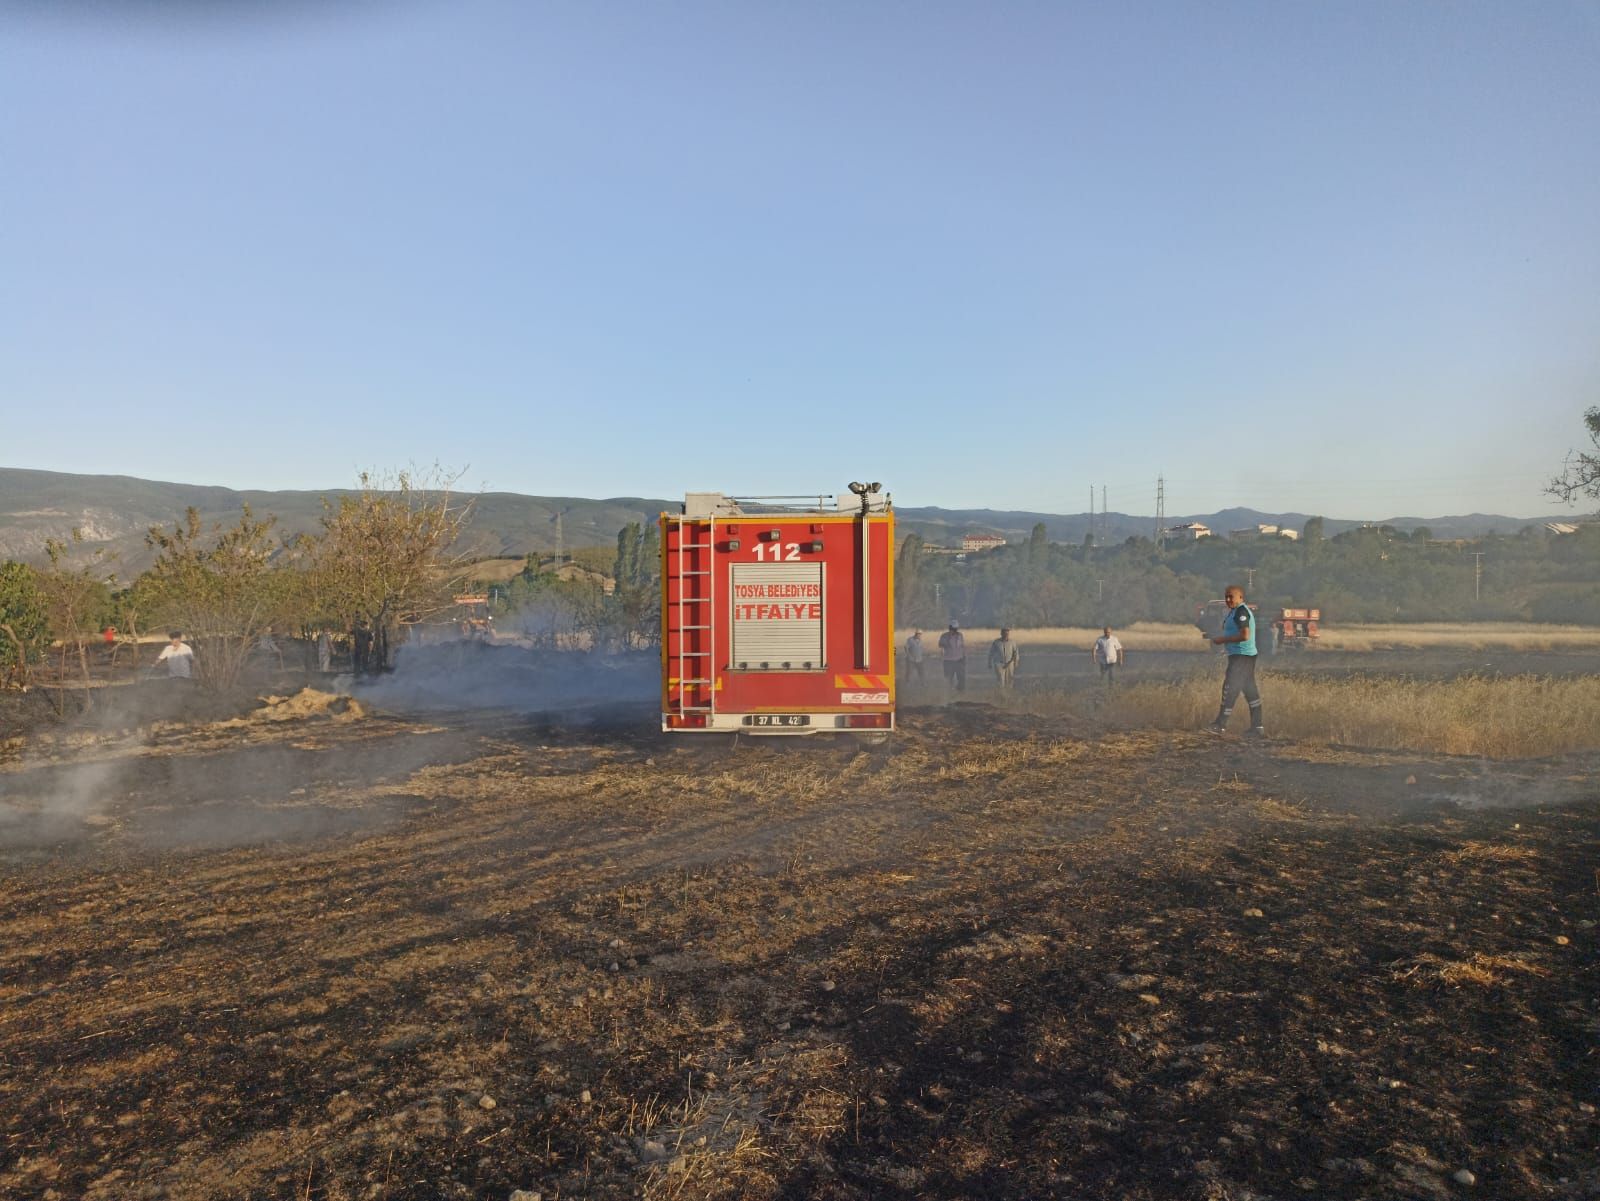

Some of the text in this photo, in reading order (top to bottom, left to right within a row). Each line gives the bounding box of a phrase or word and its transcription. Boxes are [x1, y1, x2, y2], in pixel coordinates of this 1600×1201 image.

[751, 543, 801, 561] 112
[735, 584, 765, 598] TOSYA
[758, 716, 768, 725] 37
